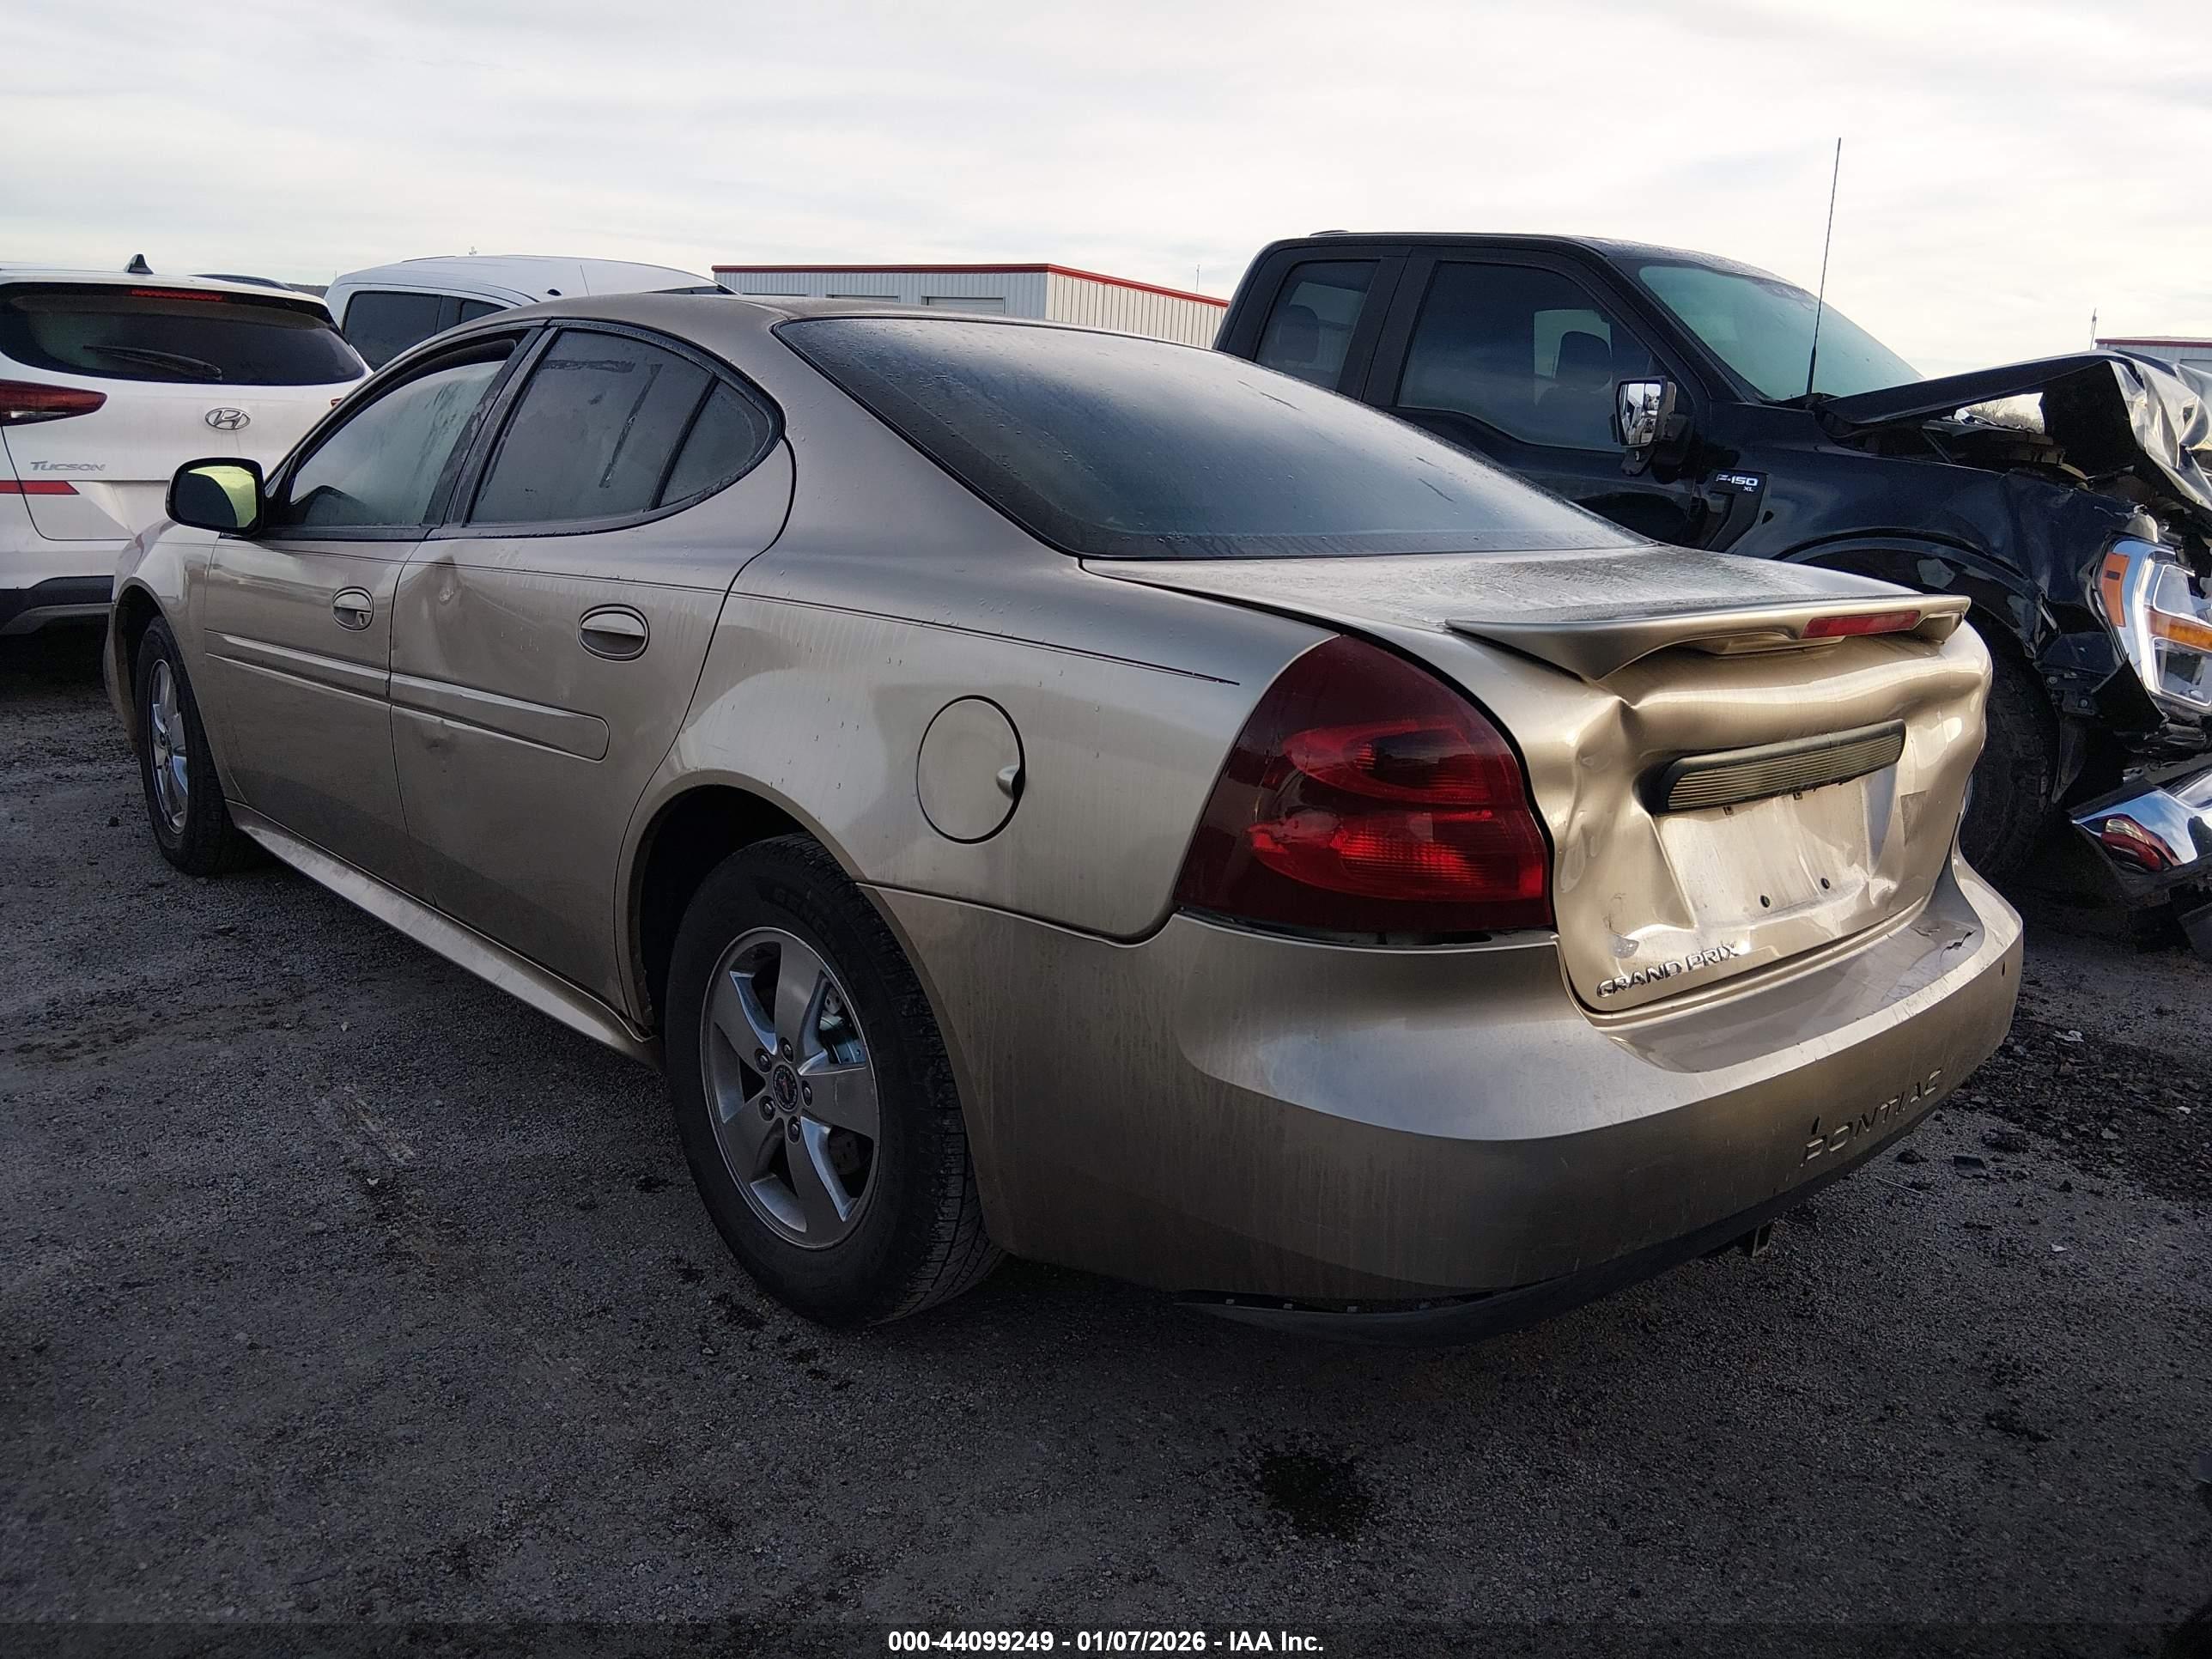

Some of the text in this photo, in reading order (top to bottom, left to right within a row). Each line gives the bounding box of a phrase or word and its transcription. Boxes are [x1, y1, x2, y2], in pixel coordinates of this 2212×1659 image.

[29, 460, 106, 471] TUCSON
[1716, 473, 1759, 486] F-150
[1595, 942, 1741, 999] GRAND PRIX
[1799, 1067, 1942, 1167] PONTIAC
